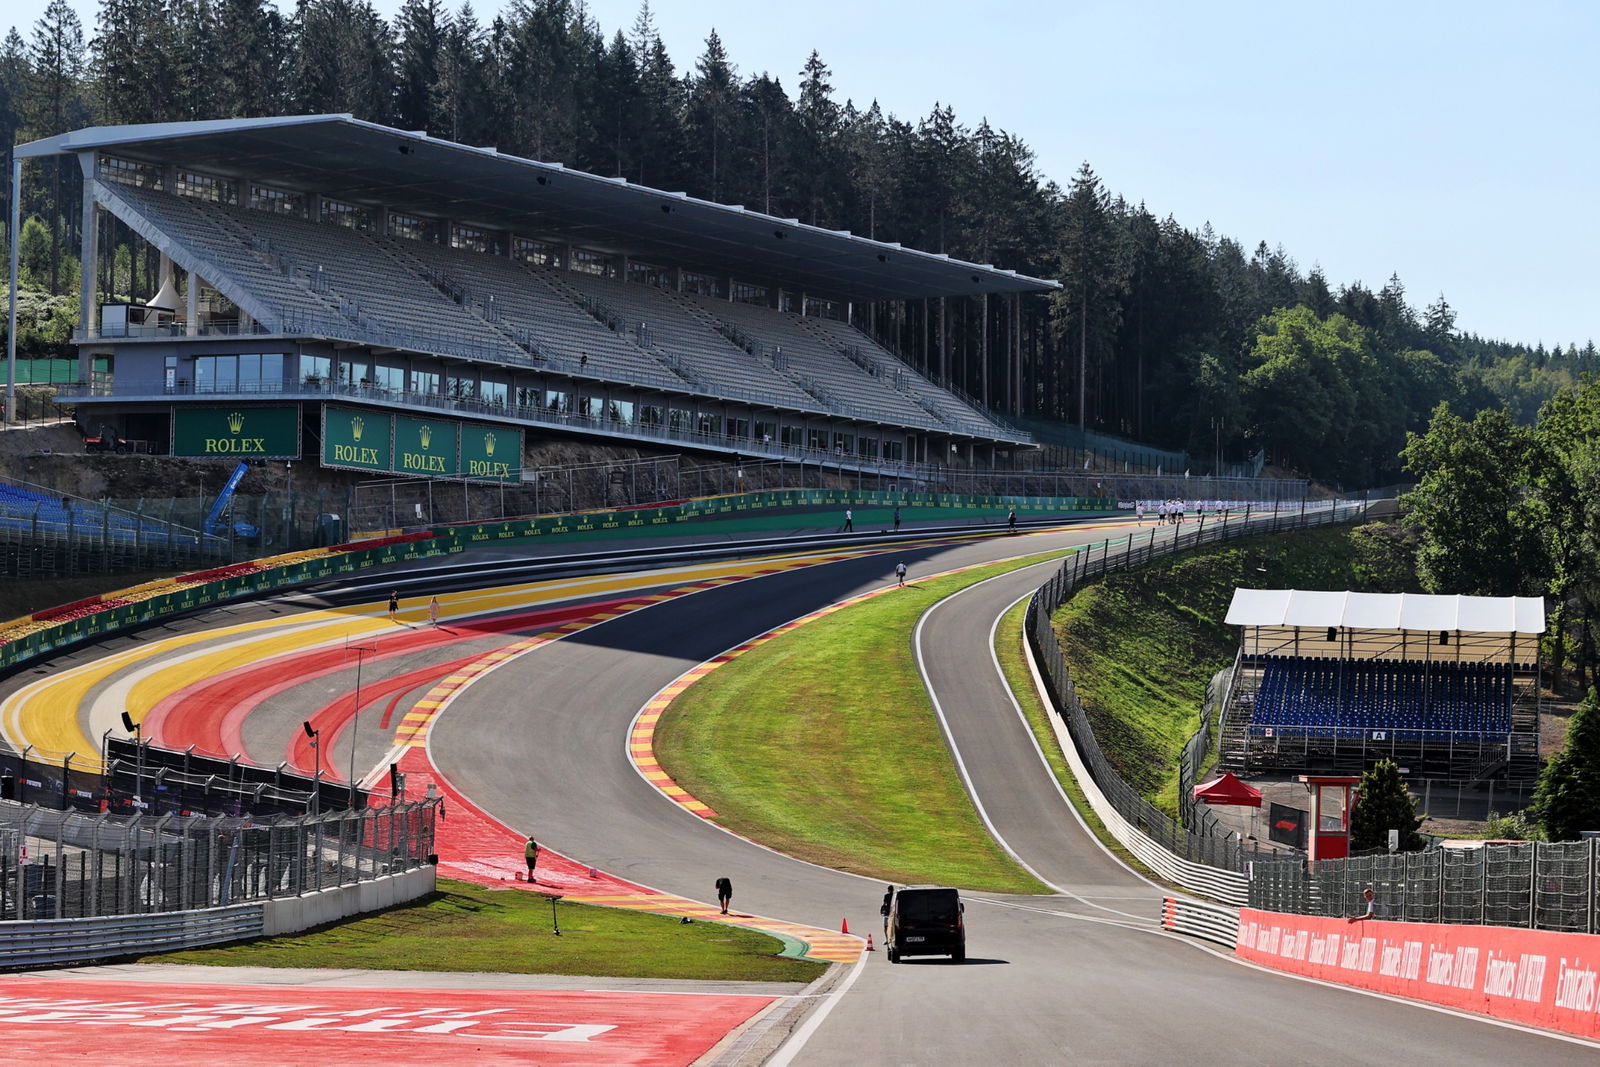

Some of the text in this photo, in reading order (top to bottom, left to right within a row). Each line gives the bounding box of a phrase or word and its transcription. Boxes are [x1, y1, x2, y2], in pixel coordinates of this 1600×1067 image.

[205, 438, 265, 453] ROLEX
[334, 444, 379, 465] ROLEX
[403, 453, 446, 472] ROLEX
[469, 460, 510, 478] ROLEX
[382, 556, 396, 564] ROLEX
[404, 552, 419, 560] ROLEX
[1484, 949, 1516, 998] Emirates
[1555, 957, 1597, 1012] Emirates
